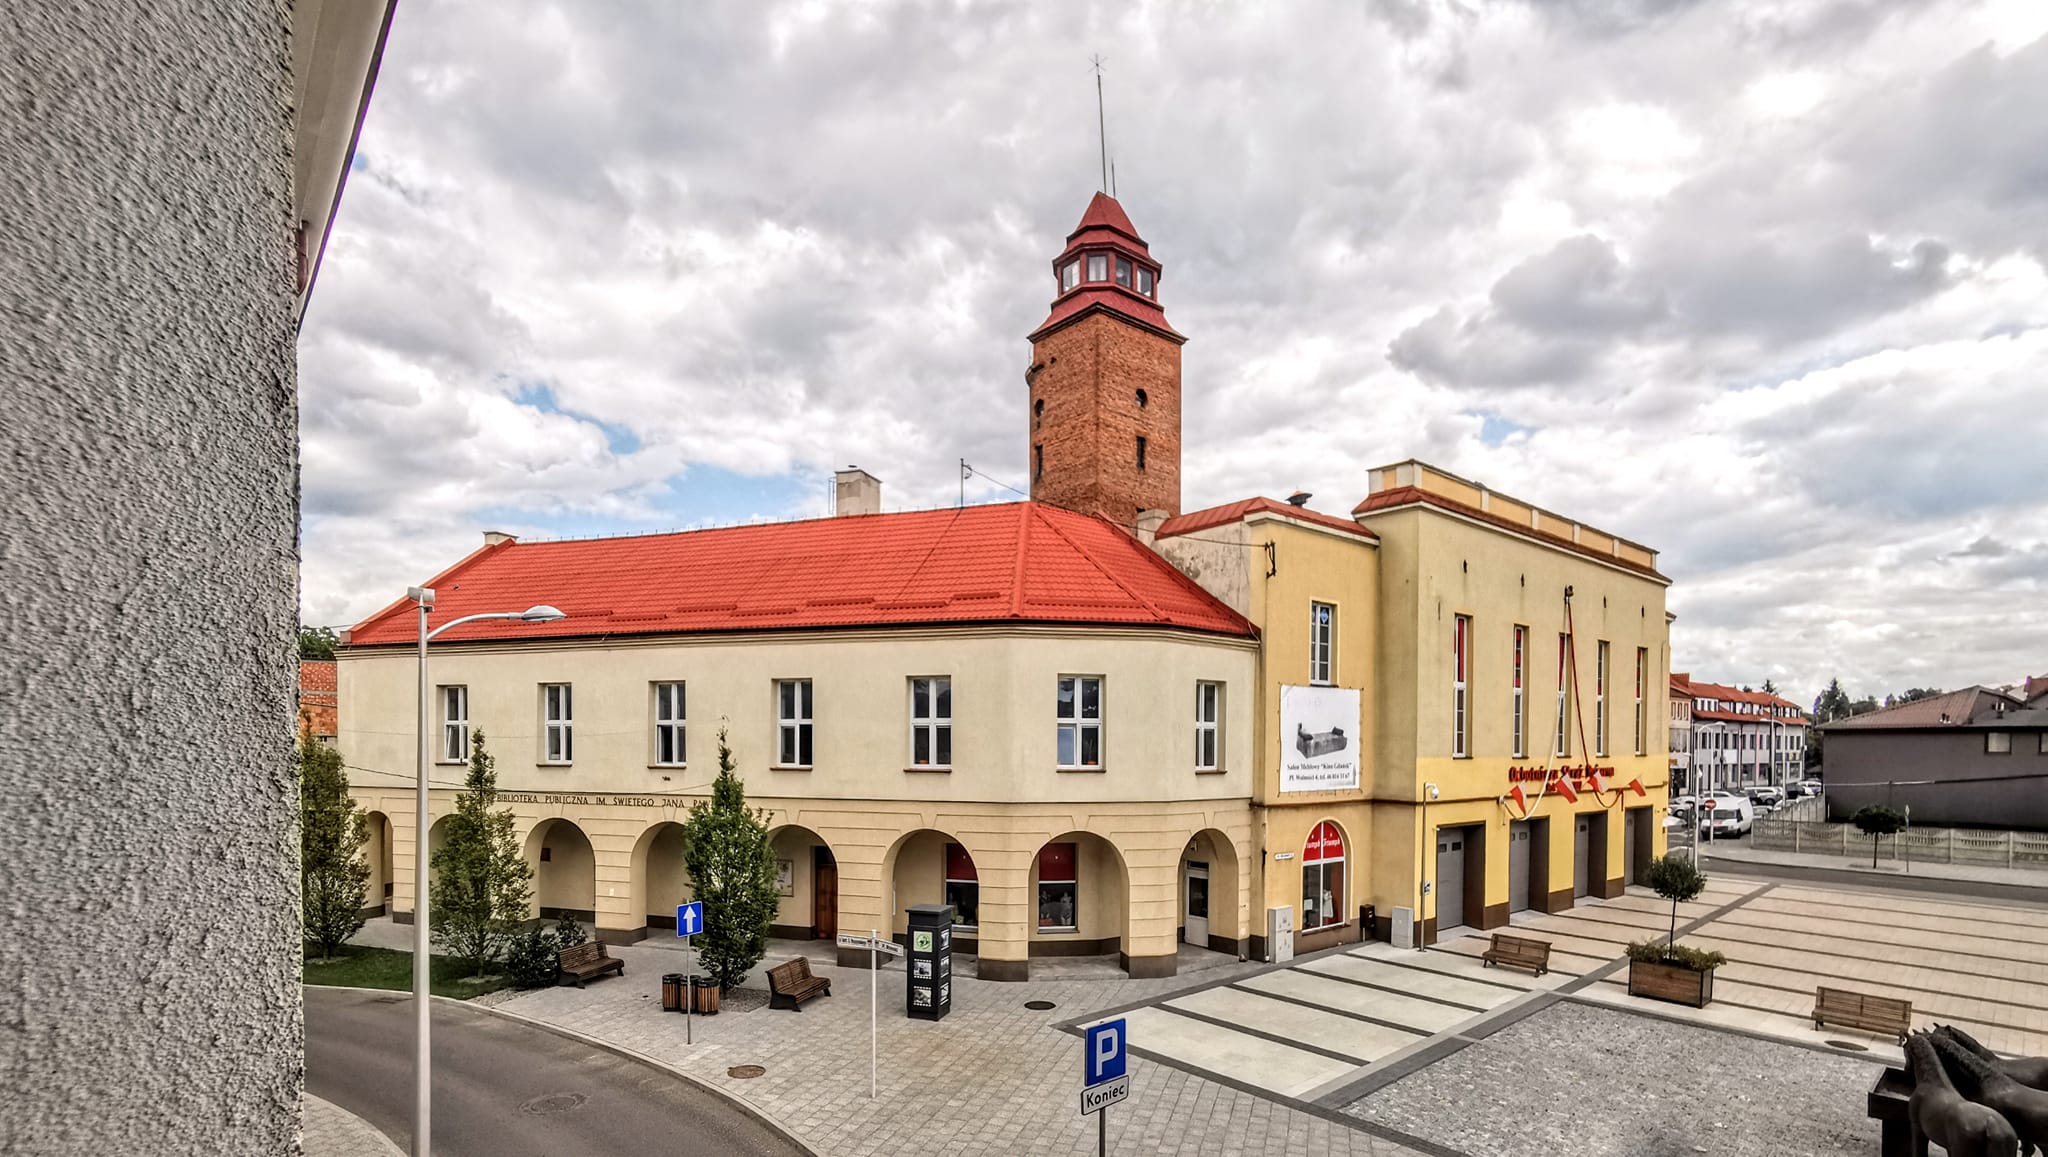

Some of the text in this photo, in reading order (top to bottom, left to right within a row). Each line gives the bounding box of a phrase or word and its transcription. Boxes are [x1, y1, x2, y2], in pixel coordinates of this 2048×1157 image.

[496, 793, 538, 803] BIBLIOTEKA
[545, 795, 588, 804] PUBLICZNA
[661, 799, 684, 808] JANA
[1095, 1027, 1118, 1077] P
[1086, 1084, 1125, 1109] Koniec
